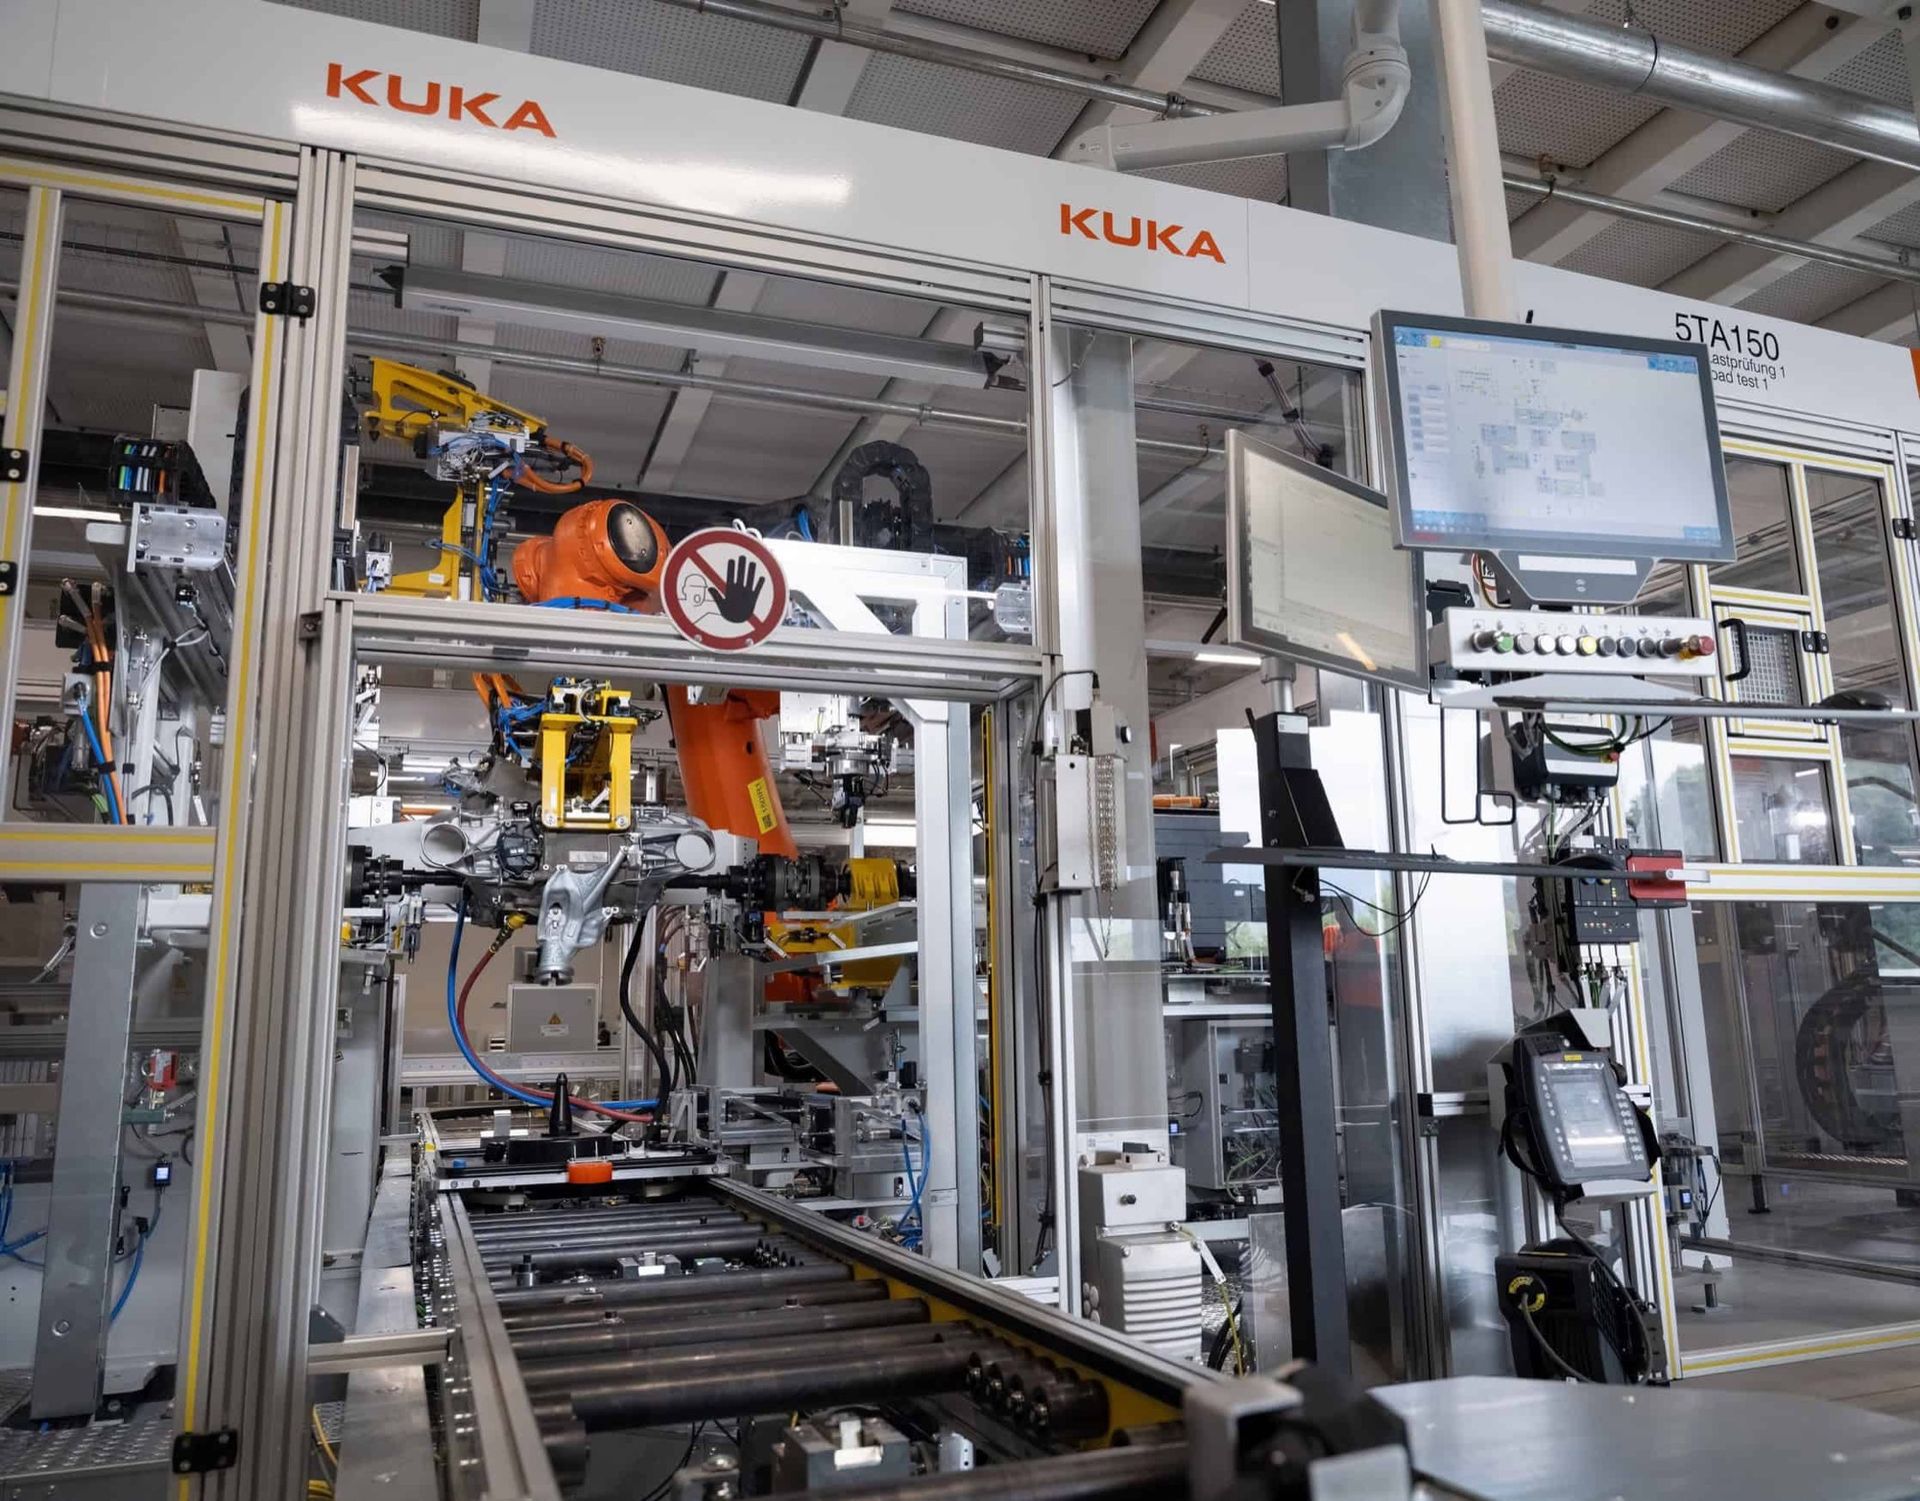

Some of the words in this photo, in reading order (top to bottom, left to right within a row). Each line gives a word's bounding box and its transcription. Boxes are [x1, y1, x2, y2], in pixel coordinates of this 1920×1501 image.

[326, 62, 558, 139] KUKA
[1060, 203, 1227, 265] KUKA
[1675, 312, 1780, 361] 5TA150
[1711, 353, 1777, 380] astprüfung
[1780, 366, 1786, 378] 1
[1711, 369, 1734, 383] oad
[1736, 373, 1760, 389] test
[1763, 378, 1768, 390] 1
